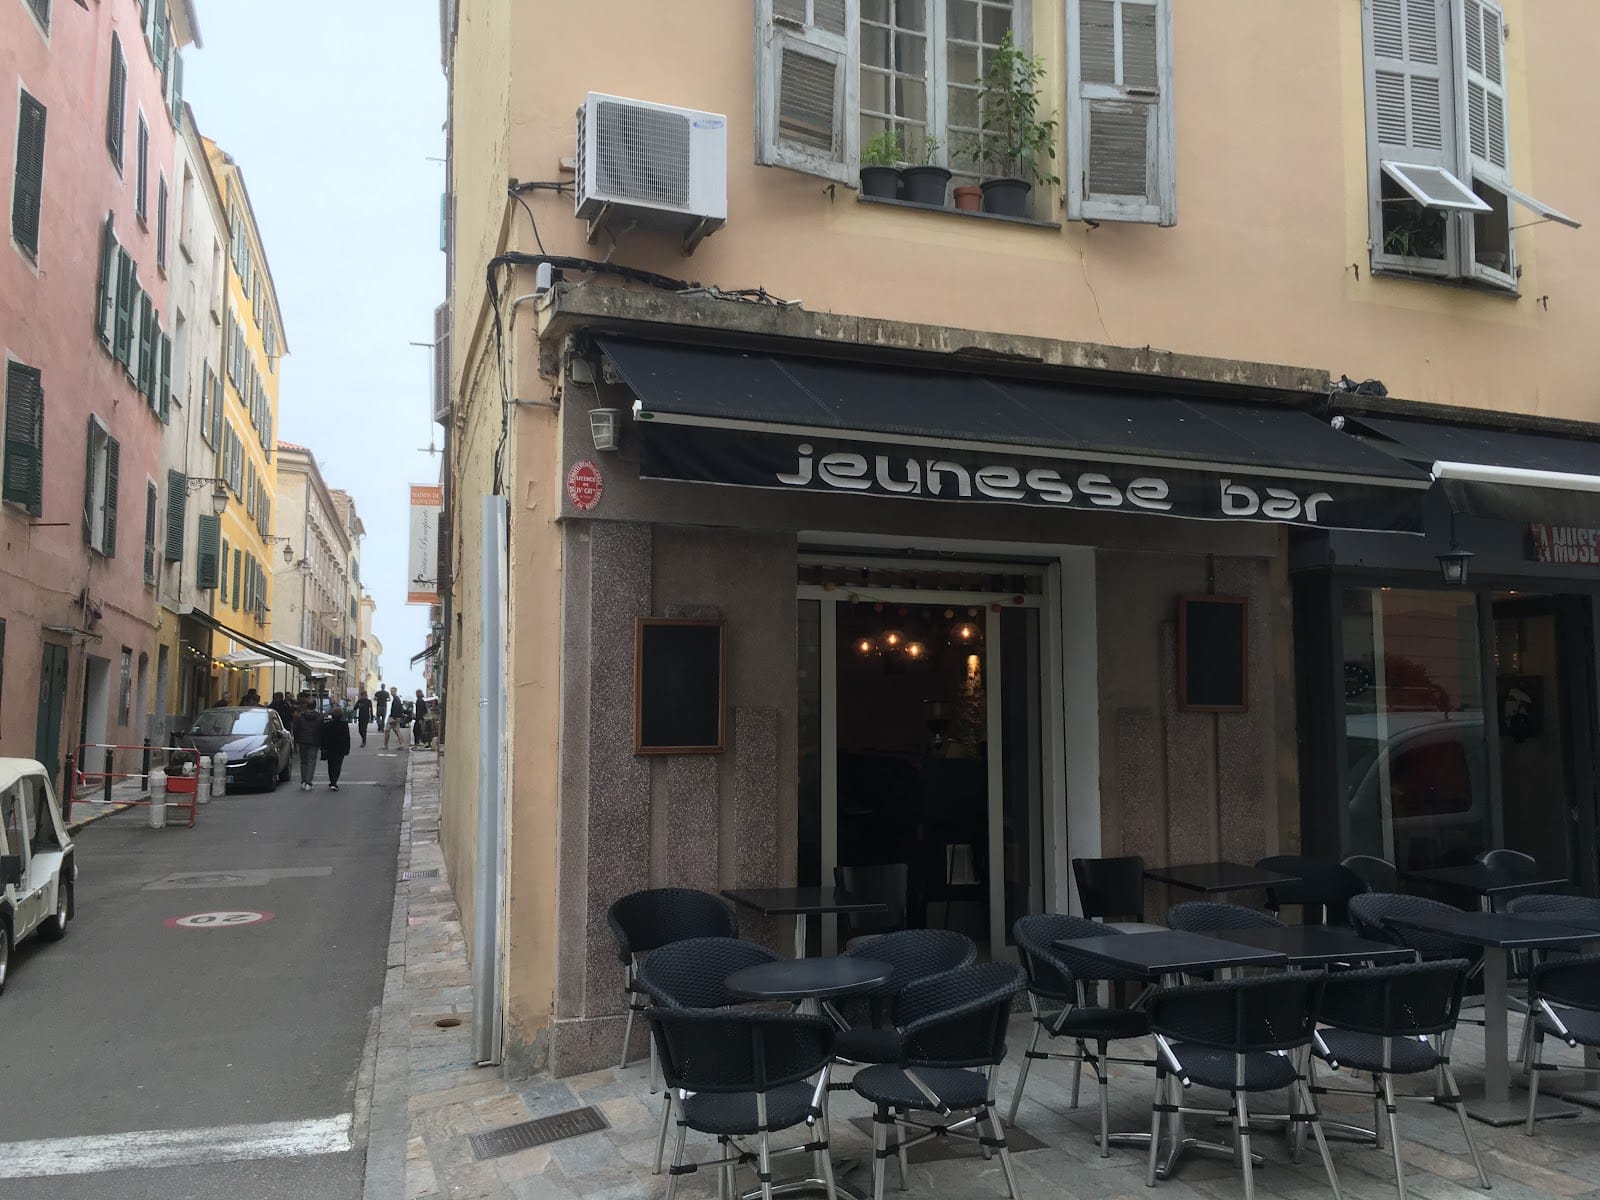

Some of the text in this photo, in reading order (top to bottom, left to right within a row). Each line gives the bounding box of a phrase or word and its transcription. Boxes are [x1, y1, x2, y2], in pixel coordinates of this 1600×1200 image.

[776, 443, 1334, 522] jeunesse bar
[190, 914, 251, 924] 20
